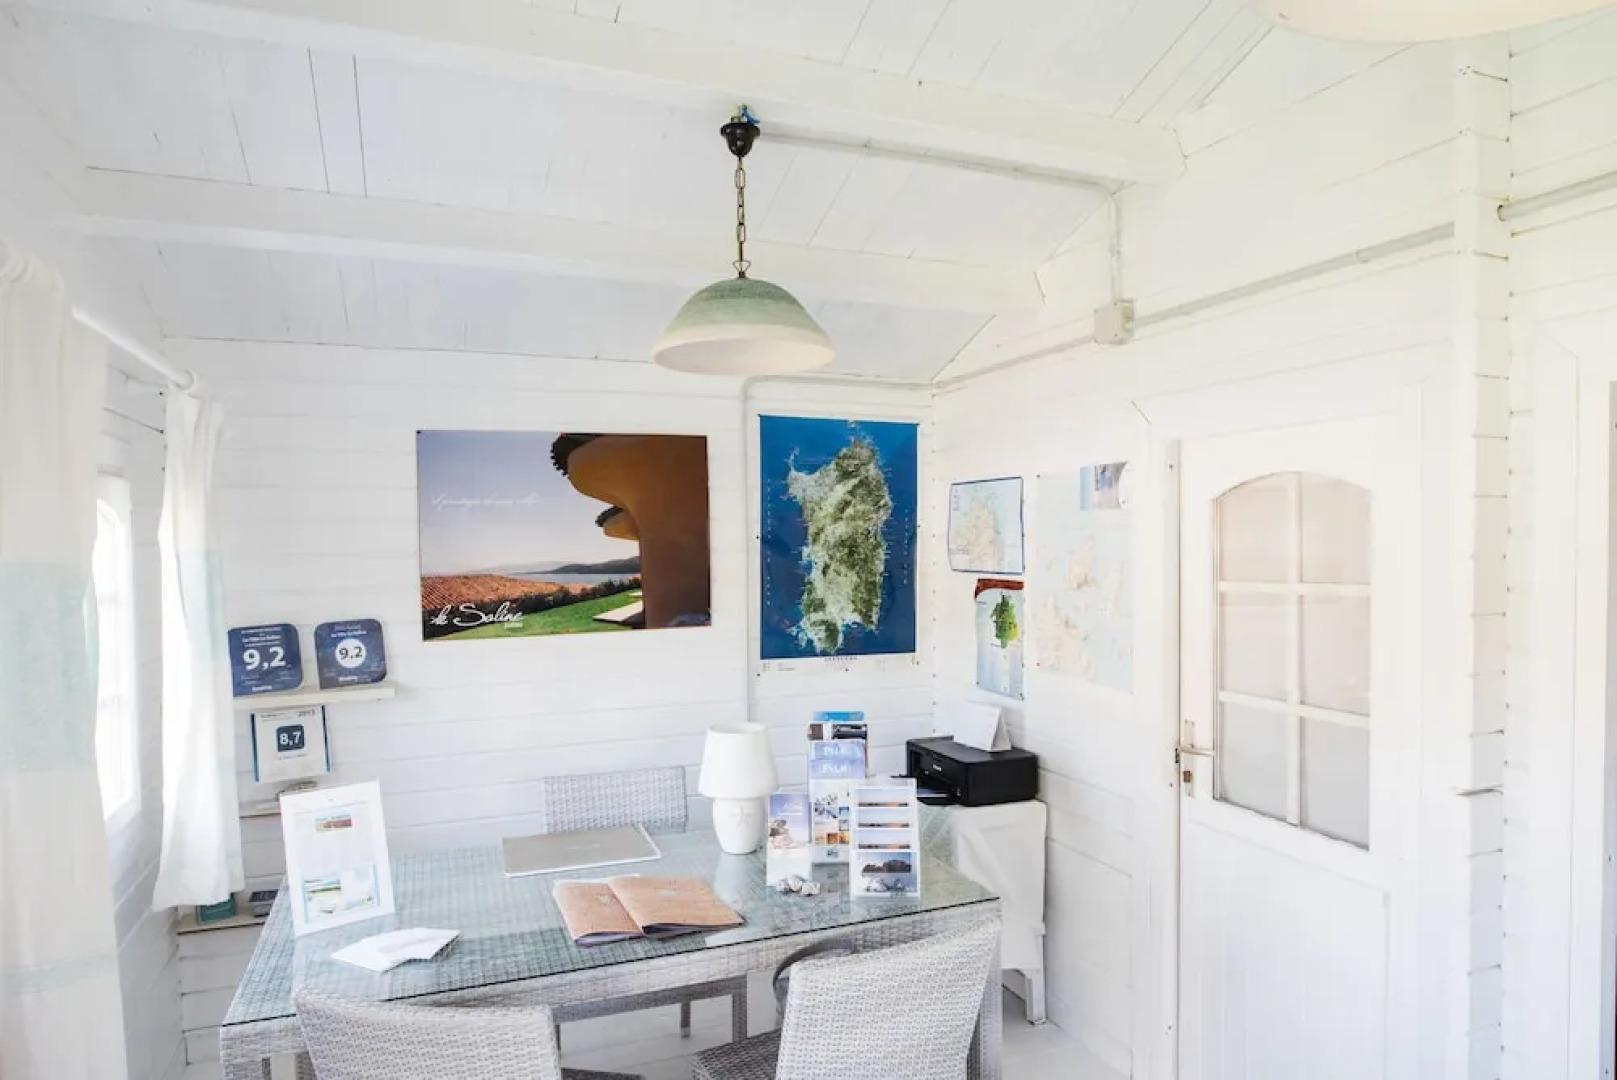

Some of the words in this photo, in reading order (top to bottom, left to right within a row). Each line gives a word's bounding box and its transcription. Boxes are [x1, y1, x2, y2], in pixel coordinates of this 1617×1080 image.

[243, 646, 287, 671] 9,2
[339, 646, 363, 660] 9.2
[279, 731, 302, 746] 8,7
